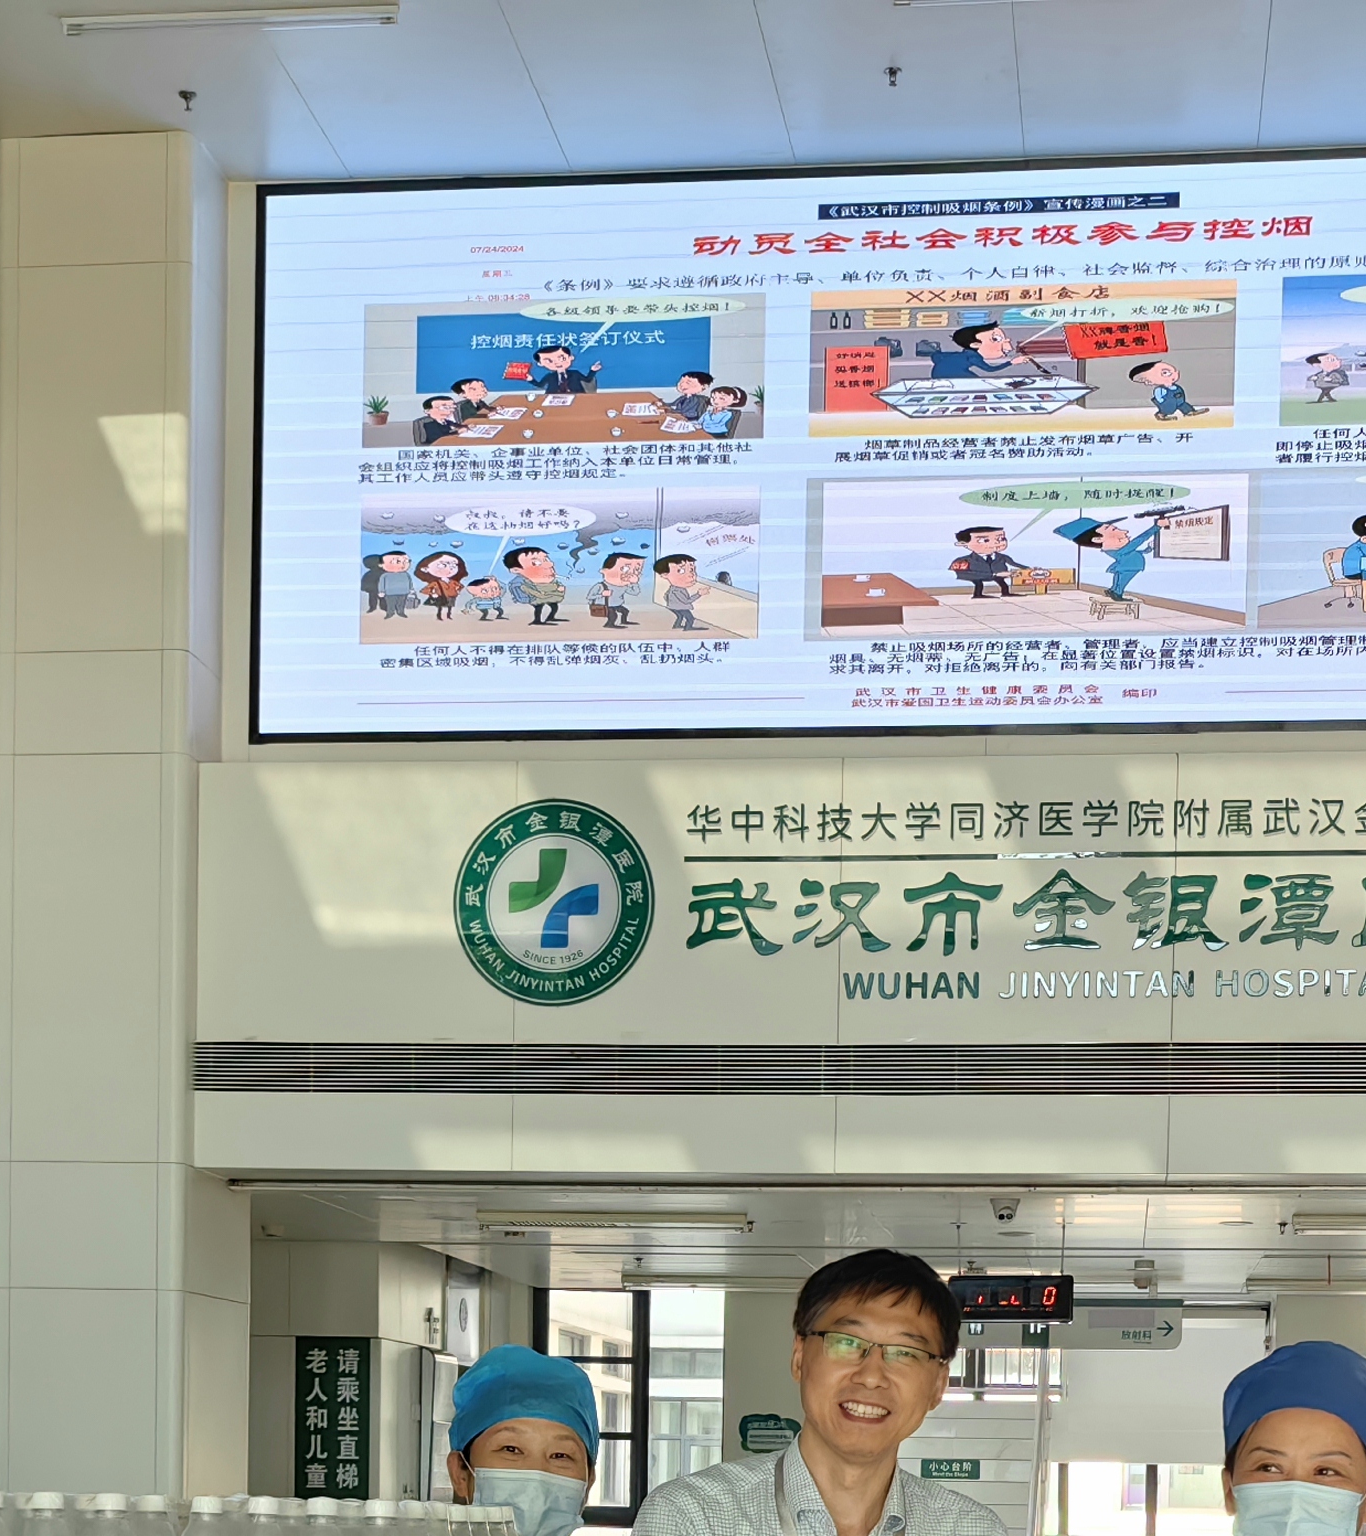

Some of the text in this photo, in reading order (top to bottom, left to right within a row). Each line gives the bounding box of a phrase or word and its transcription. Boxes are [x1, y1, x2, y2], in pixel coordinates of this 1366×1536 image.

[692, 216, 1312, 257] 动员全社会积极参与控烟
[470, 245, 524, 254] 07/24/2024
[471, 329, 664, 349] 控烟责任状签订仪式
[851, 695, 1103, 708] 武汉市爱国卫生运动委员会办公室
[855, 684, 1157, 699] 武汉市卫生健康委员会 编印
[465, 810, 644, 907] 武汉市金银潭医院
[469, 916, 640, 993] WUHAN JINYINTAN HOSPITAL
[522, 948, 585, 965] SINCE 1926
[842, 970, 980, 1000] WUHAN
[998, 969, 1196, 999] JINYINTAN
[1121, 1329, 1153, 1341] 放射科
[304, 1347, 328, 1488] 老人和儿童
[336, 1348, 361, 1489] 请乘坐直梯
[929, 1461, 972, 1472] 小心台阶
